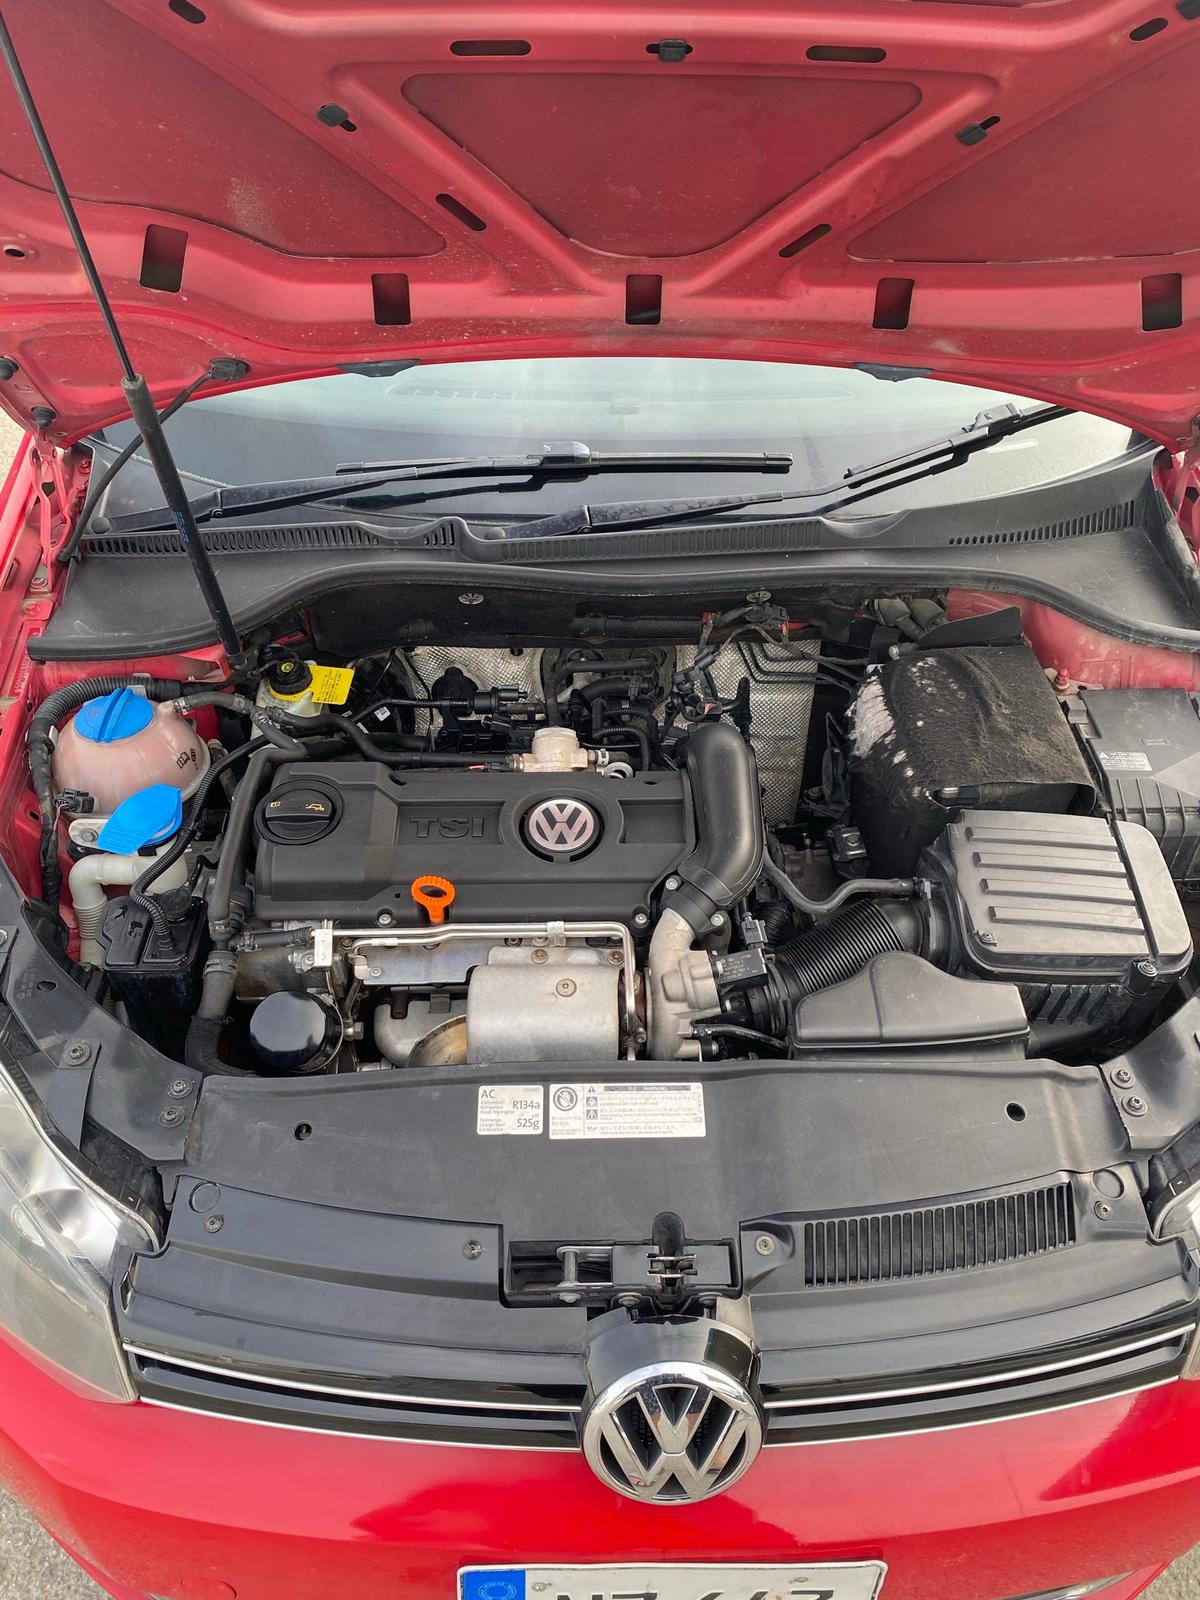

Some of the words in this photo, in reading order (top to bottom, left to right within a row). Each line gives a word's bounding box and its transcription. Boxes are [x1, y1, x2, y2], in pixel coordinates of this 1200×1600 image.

[408, 816, 485, 838] TSI
[530, 799, 593, 850] VW
[480, 1089, 496, 1099] AC
[512, 1100, 540, 1110] R134a
[517, 1118, 540, 1131] 525g
[587, 1366, 758, 1505] VW
